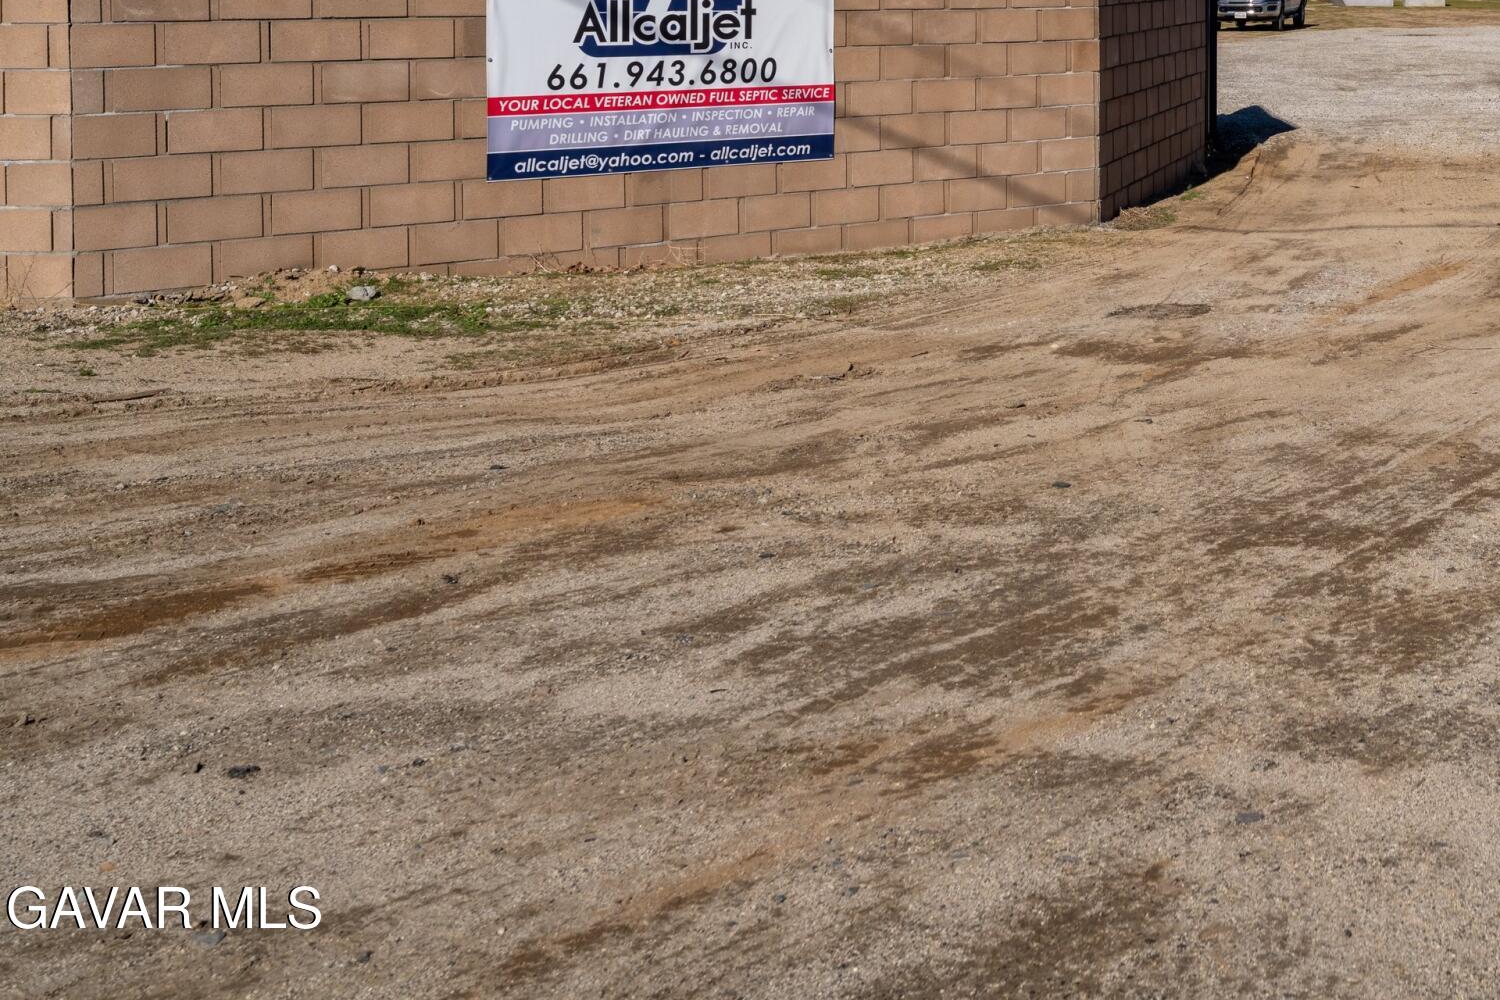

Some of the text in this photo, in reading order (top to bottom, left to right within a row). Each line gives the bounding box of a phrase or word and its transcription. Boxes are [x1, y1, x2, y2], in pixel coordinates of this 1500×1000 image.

[729, 41, 753, 50] INC.
[547, 57, 777, 91] 661.943.6800
[499, 87, 831, 112] YOUR LOCAL VETERAN OWNED FULL SEPTIC SERVICE
[510, 106, 816, 131] PUMPING INSTALLATION INSPECTION REPAIR
[549, 122, 783, 145] DRILLING DIRT HAULING & REMOVAL
[514, 151, 694, 174] allcaljet@yahoo.com
[710, 144, 811, 161] allcaljet.com
